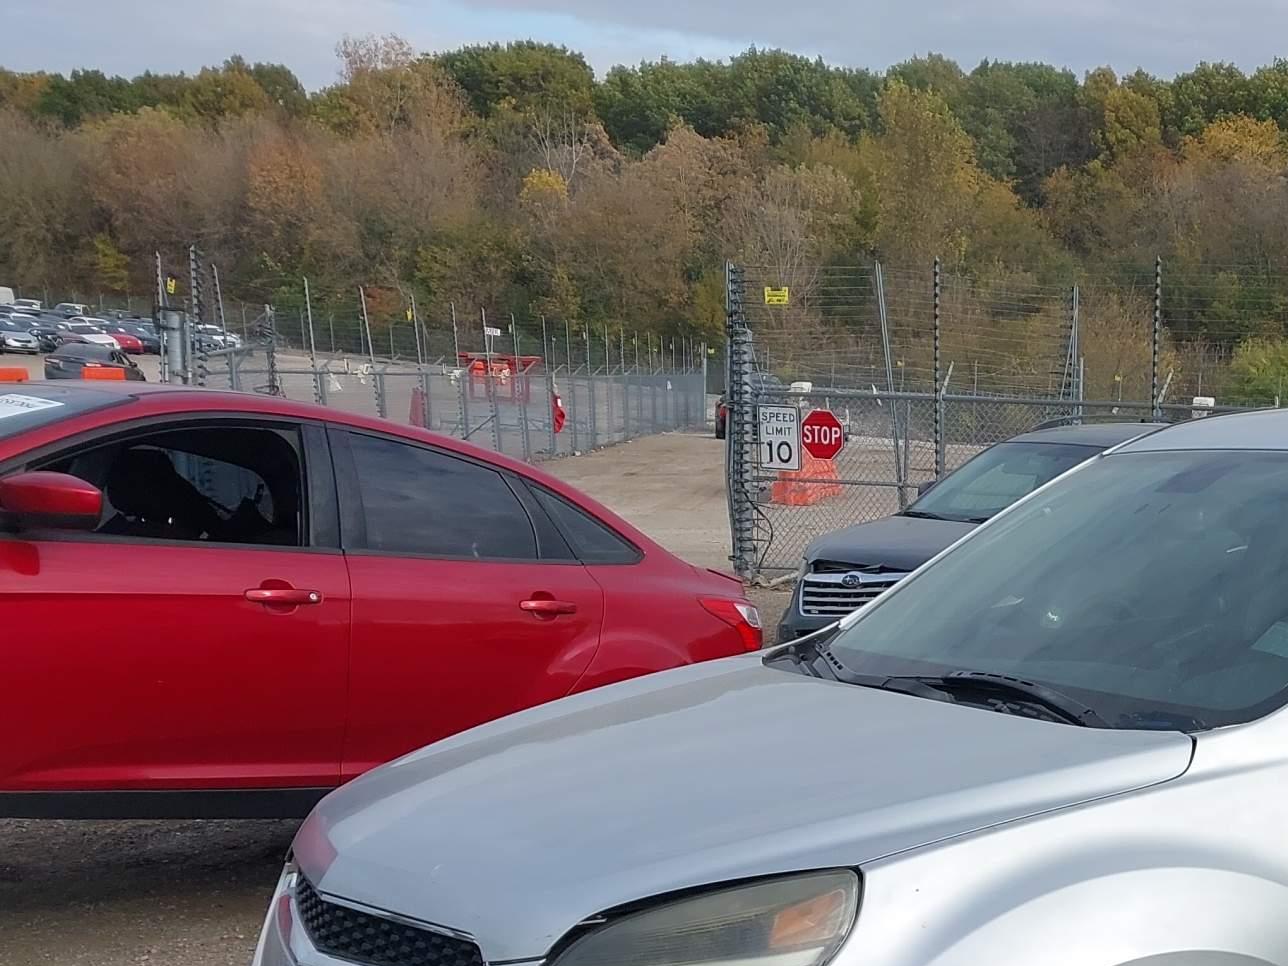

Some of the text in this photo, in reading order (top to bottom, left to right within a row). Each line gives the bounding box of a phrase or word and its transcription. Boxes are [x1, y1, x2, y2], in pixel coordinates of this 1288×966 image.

[761, 412, 795, 423] SPEED
[766, 427, 792, 436] LIMIT
[803, 426, 841, 445] STOP
[767, 441, 792, 463] 10
